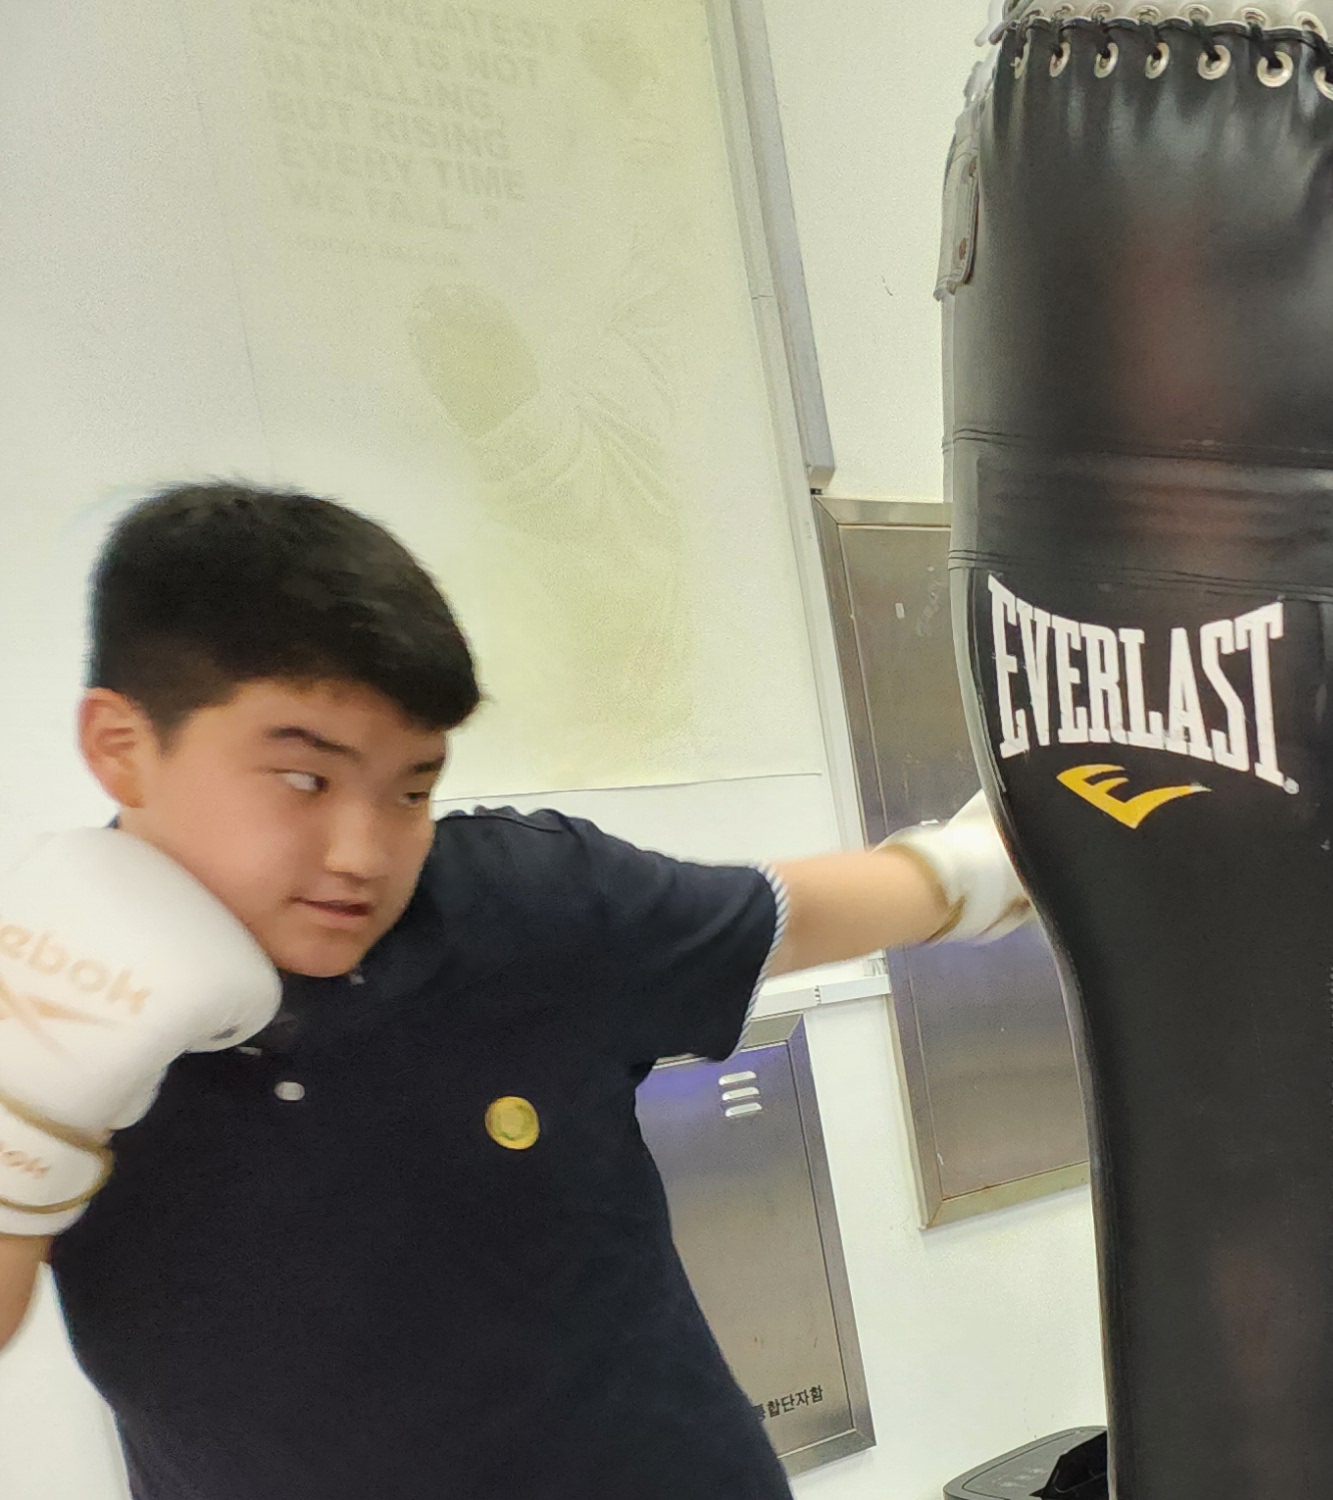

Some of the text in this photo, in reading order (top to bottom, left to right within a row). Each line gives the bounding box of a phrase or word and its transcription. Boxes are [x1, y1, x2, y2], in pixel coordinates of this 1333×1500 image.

[411, 36, 450, 72] IS
[462, 49, 541, 89] NOT
[267, 89, 511, 162] BUT RISING
[278, 133, 527, 201] EVERY TIME
[988, 574, 1286, 788] EVERLAST
